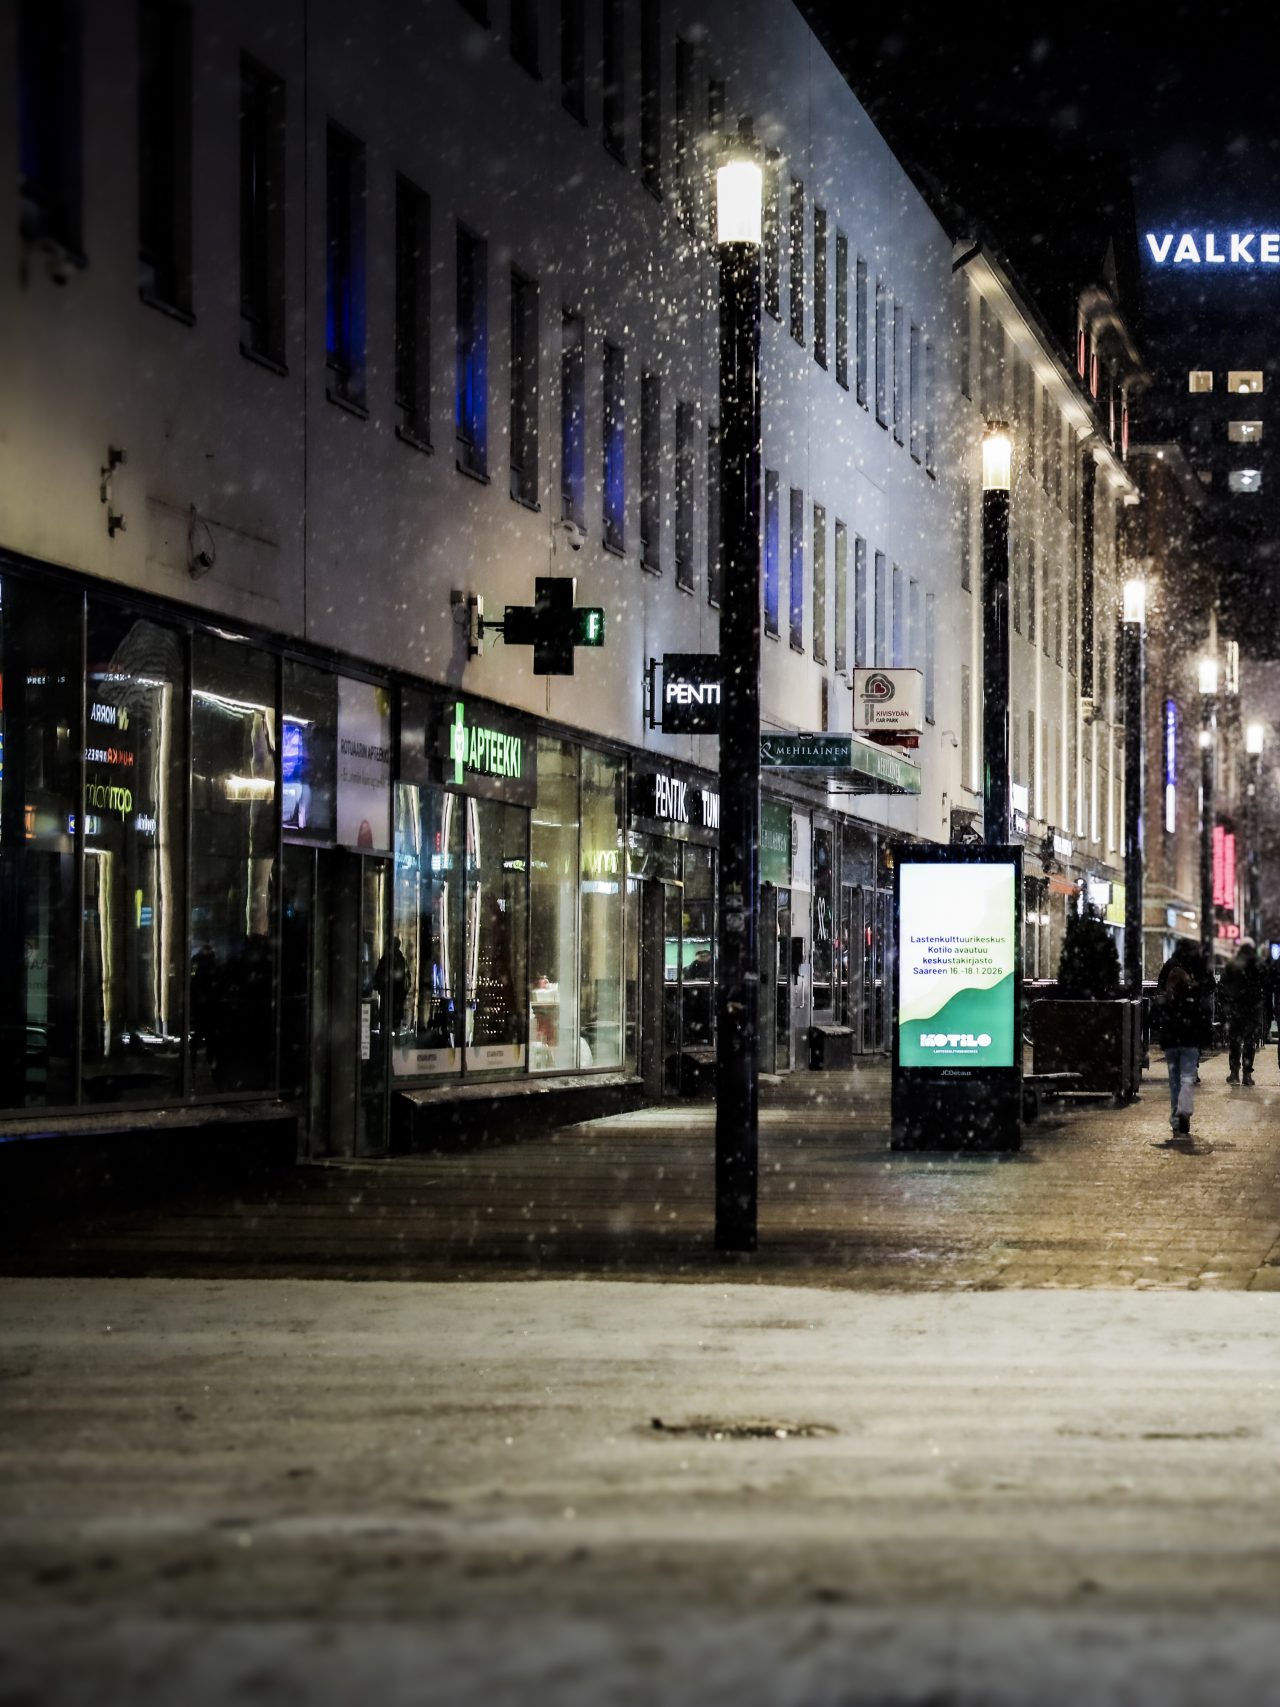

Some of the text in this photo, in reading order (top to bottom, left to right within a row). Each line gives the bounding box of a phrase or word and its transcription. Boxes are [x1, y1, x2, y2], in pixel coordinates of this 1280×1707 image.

[665, 683, 720, 704] PENTI
[468, 726, 522, 779] APTEEKKI
[910, 935, 1006, 943] Lastenkulttuurikeskus
[922, 957, 993, 966] keskustakirjasto
[913, 967, 1003, 975] Saareen 16.-18.1.2026
